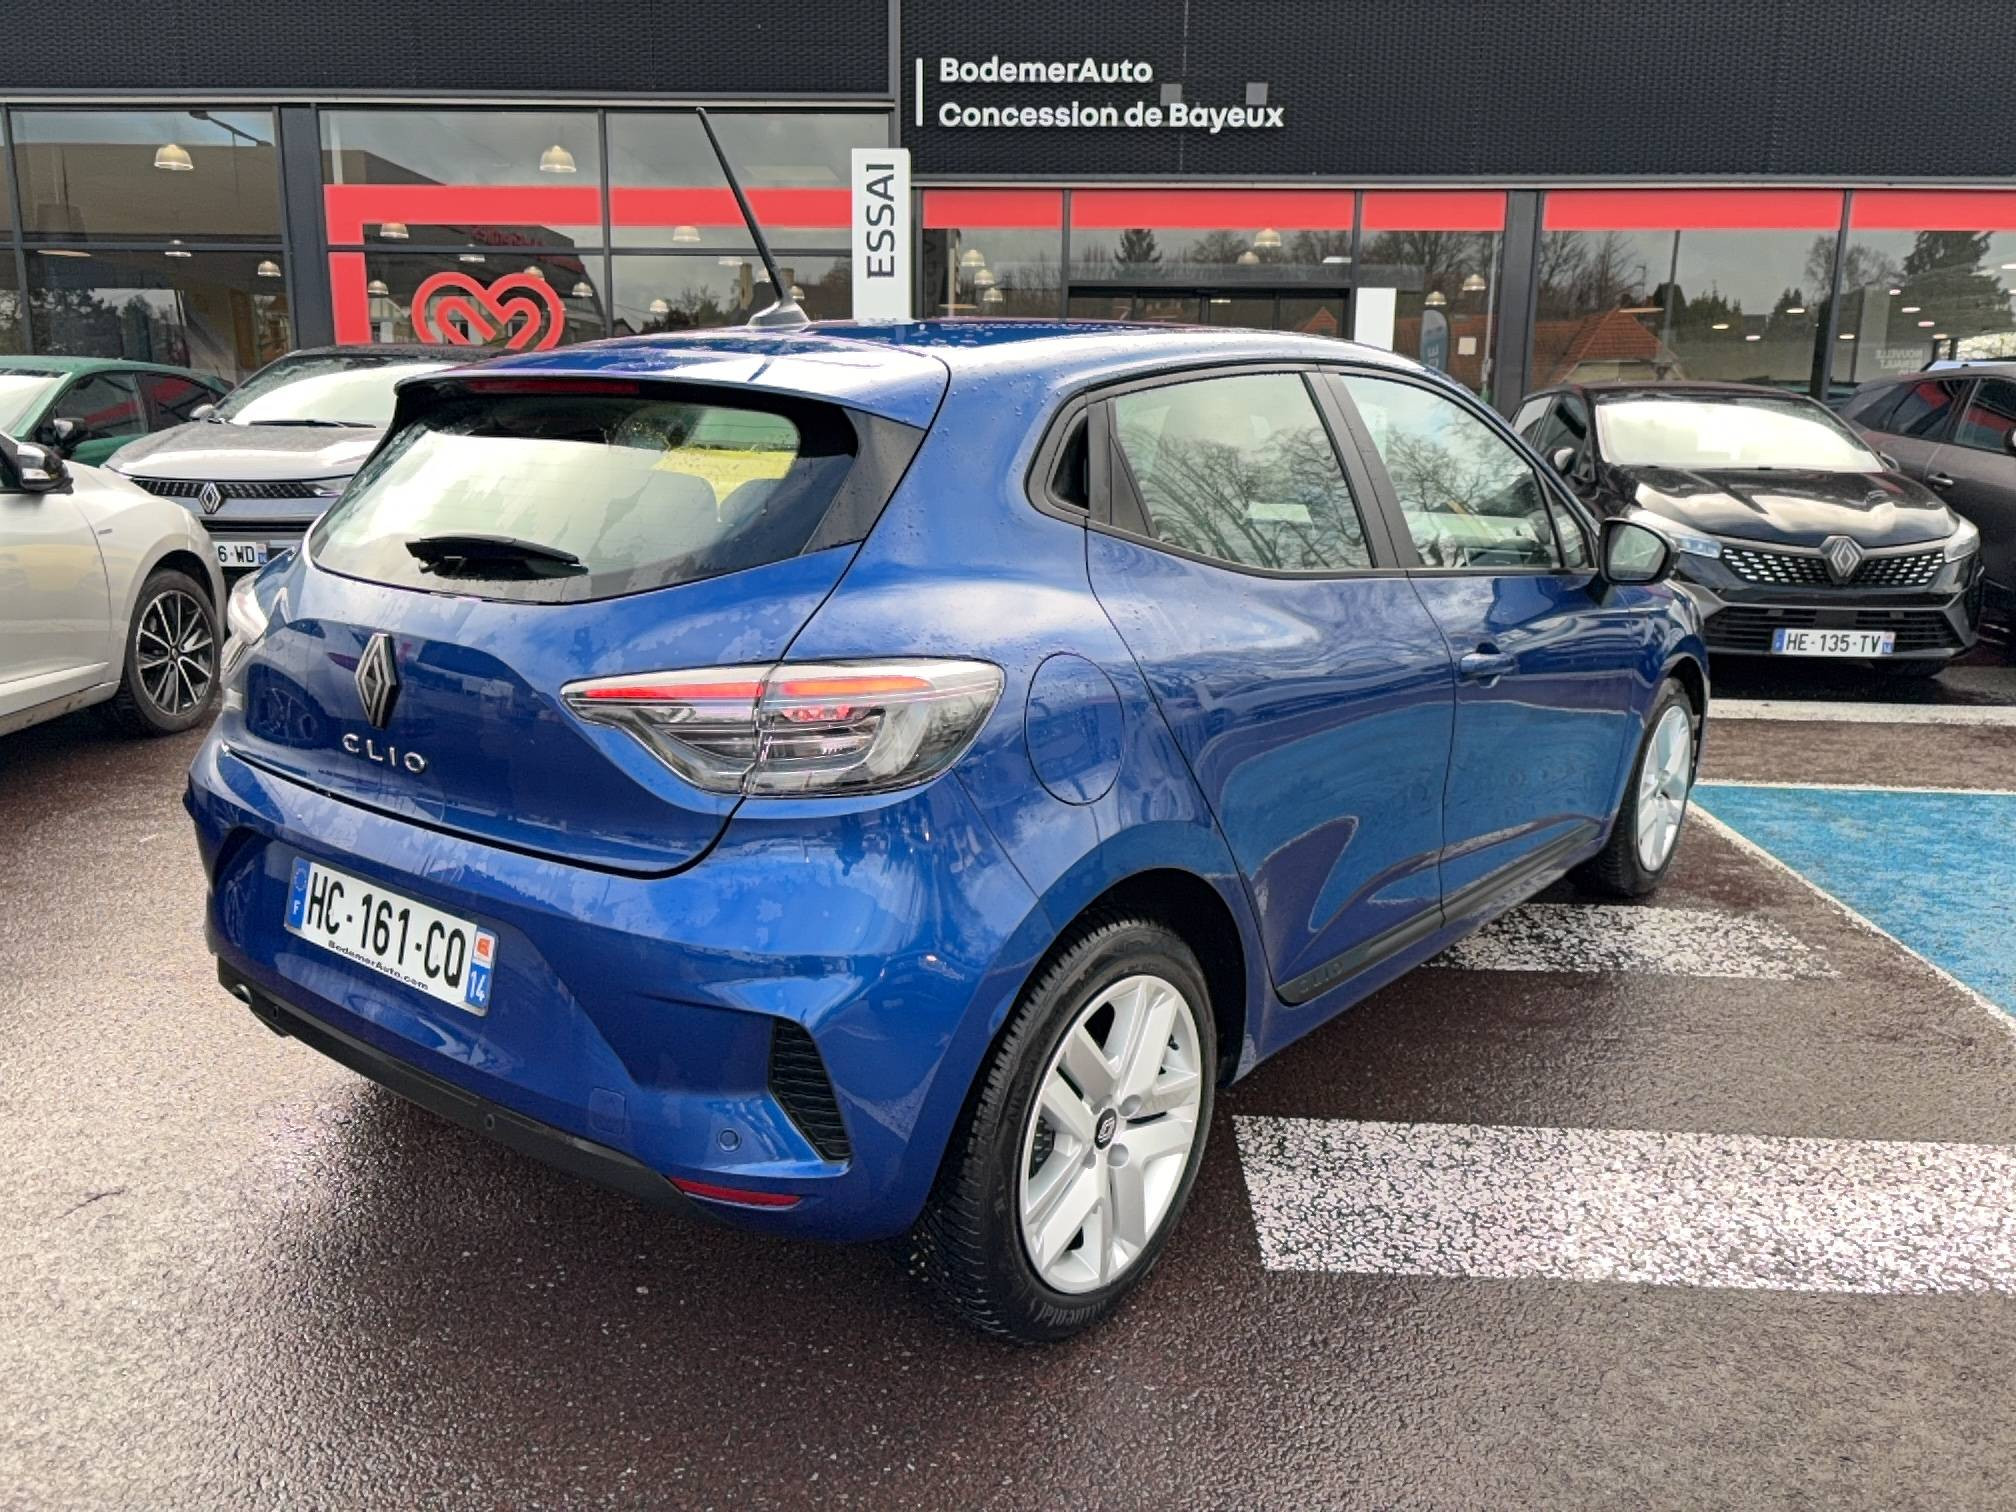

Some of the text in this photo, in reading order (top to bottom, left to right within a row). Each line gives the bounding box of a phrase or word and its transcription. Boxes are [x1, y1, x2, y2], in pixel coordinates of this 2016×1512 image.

[939, 54, 1153, 83] BodemerAuto
[938, 100, 1285, 133] Concession de Bayeux
[866, 163, 895, 279] ESSAI
[342, 732, 426, 774] CLIO
[327, 940, 429, 991] BodemerAuto.com
[469, 969, 486, 1002] 14
